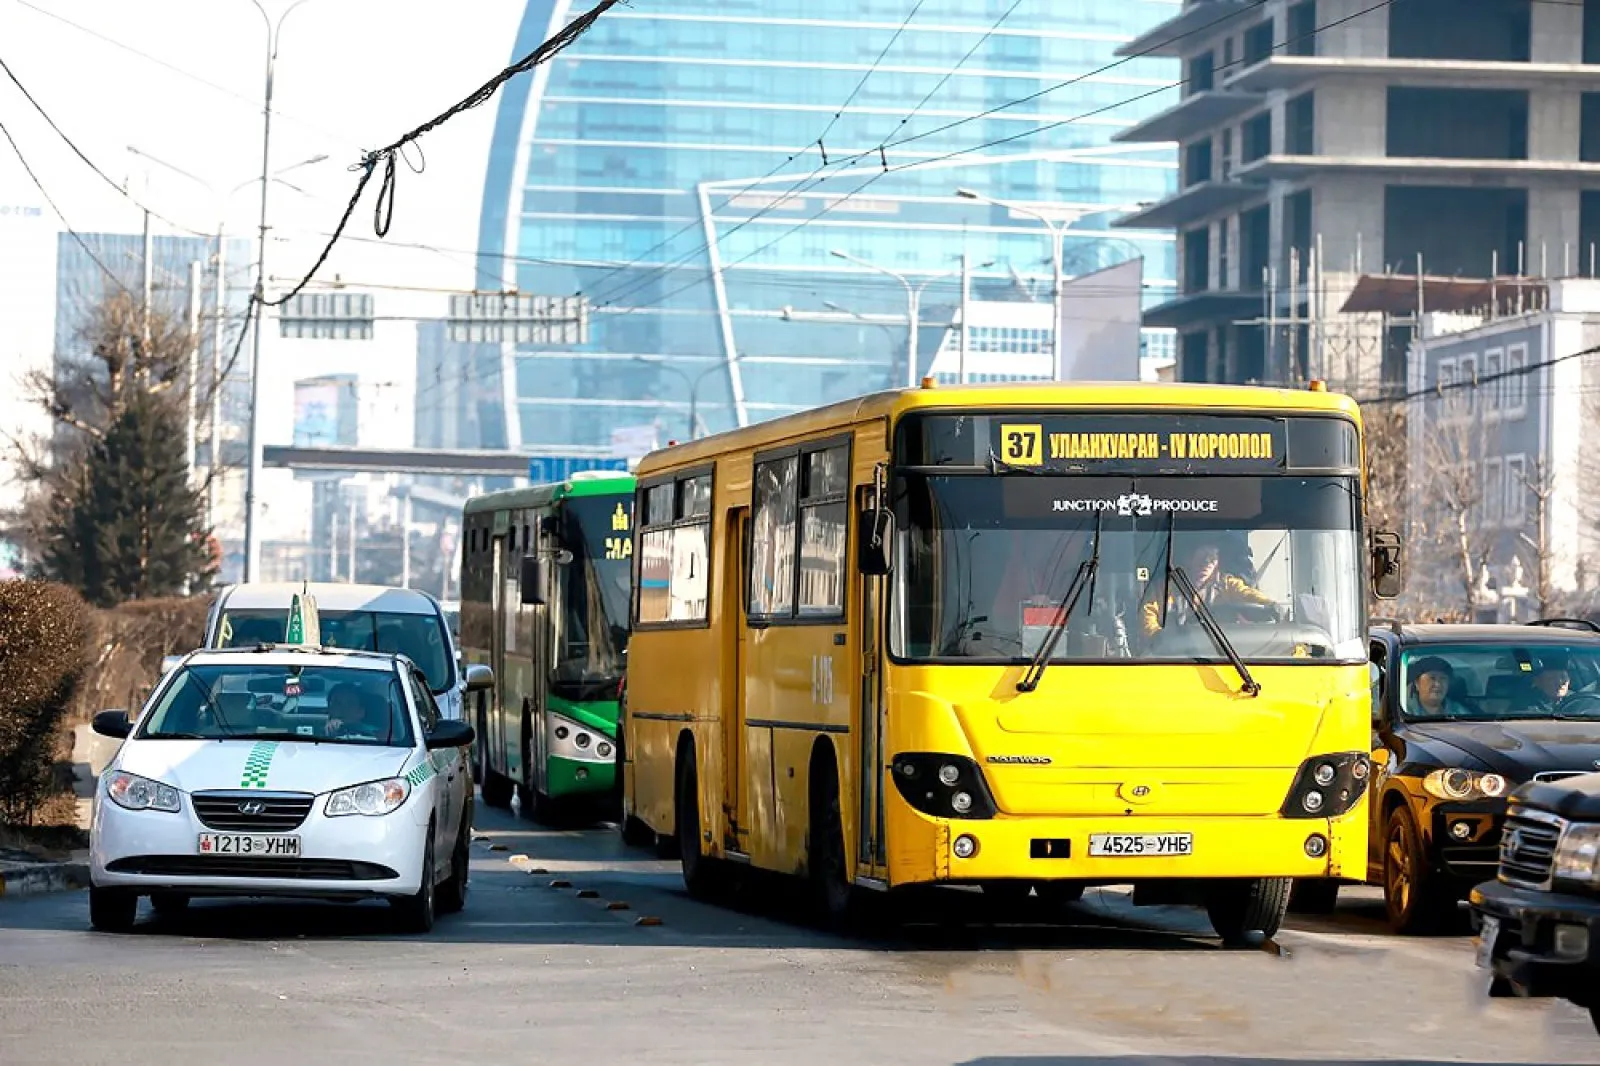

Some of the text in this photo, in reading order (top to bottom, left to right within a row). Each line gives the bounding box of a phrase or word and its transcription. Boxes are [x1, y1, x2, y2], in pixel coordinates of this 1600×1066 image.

[1007, 432, 1036, 458] 37
[1050, 433, 1159, 459] УЛААНХУАРАН
[1170, 433, 1187, 459] IV
[1188, 433, 1273, 459] ХОРООЛОЛ
[1052, 499, 1218, 512] JUNCTION PRODUCE
[213, 835, 297, 853] 1213 УНМ
[1102, 836, 1188, 853] 4525 УНБ
